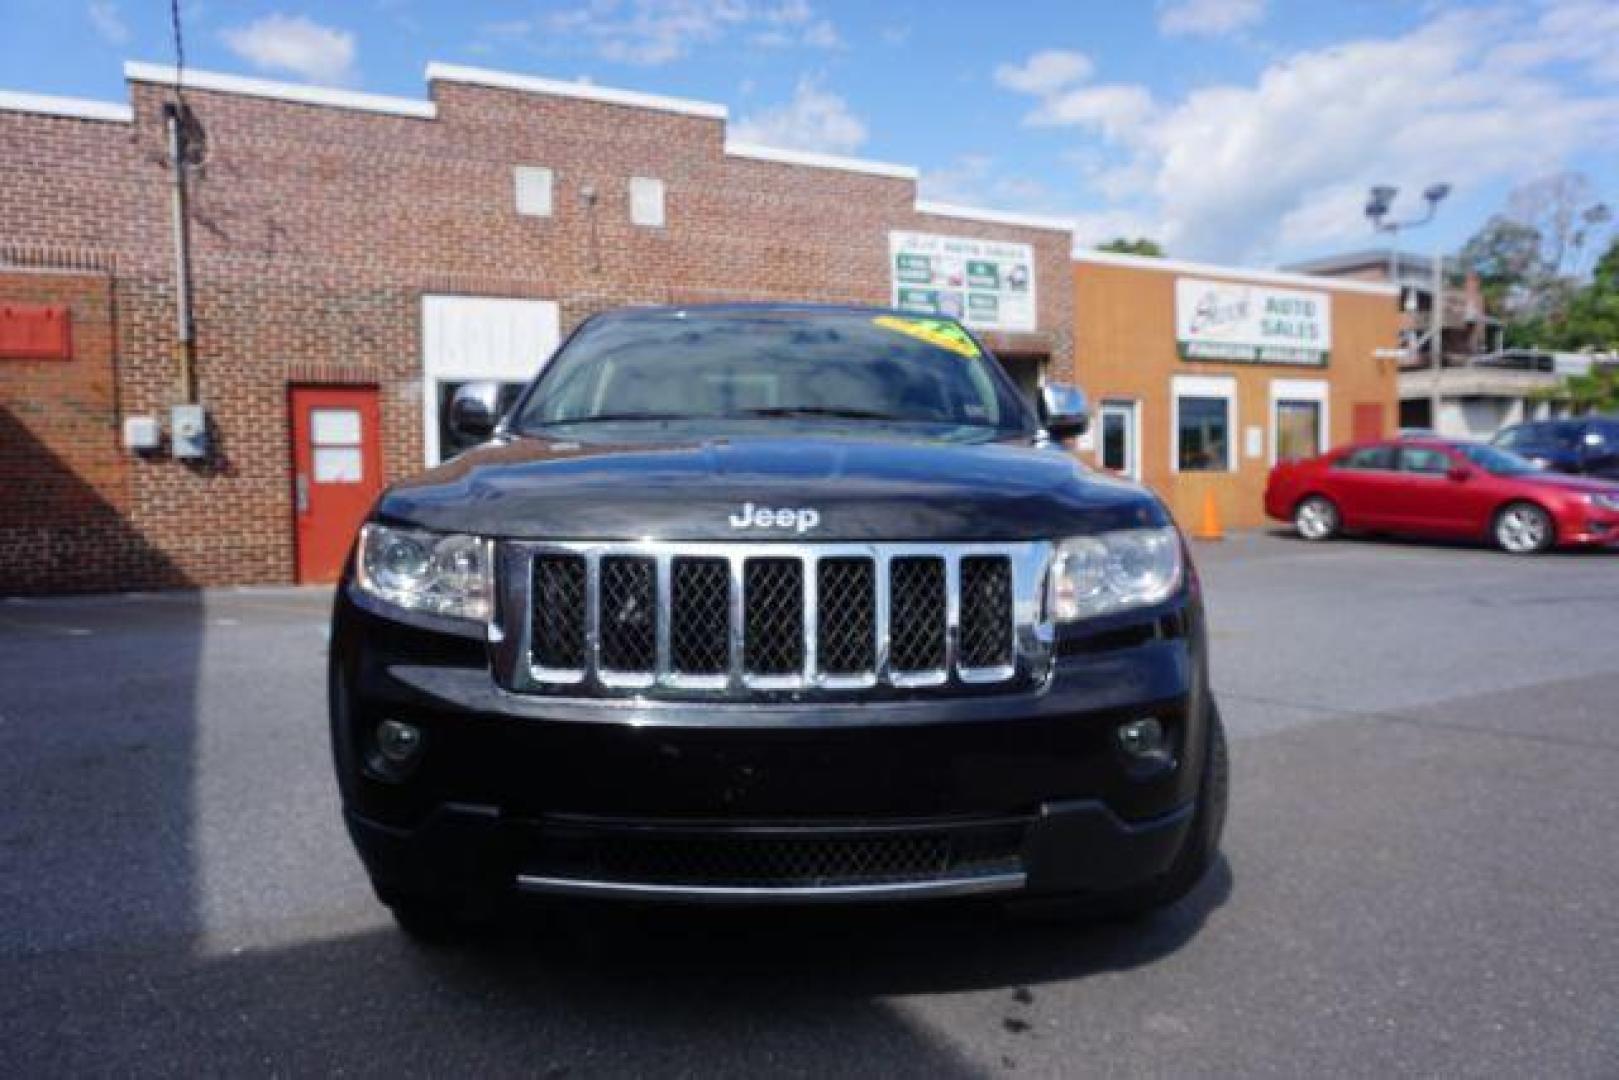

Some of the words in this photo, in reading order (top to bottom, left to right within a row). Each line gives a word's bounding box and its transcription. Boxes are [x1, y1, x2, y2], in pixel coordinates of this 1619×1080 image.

[1264, 297, 1317, 317] AUTO
[1262, 318, 1319, 339] SALES
[728, 502, 820, 533] Jeep
